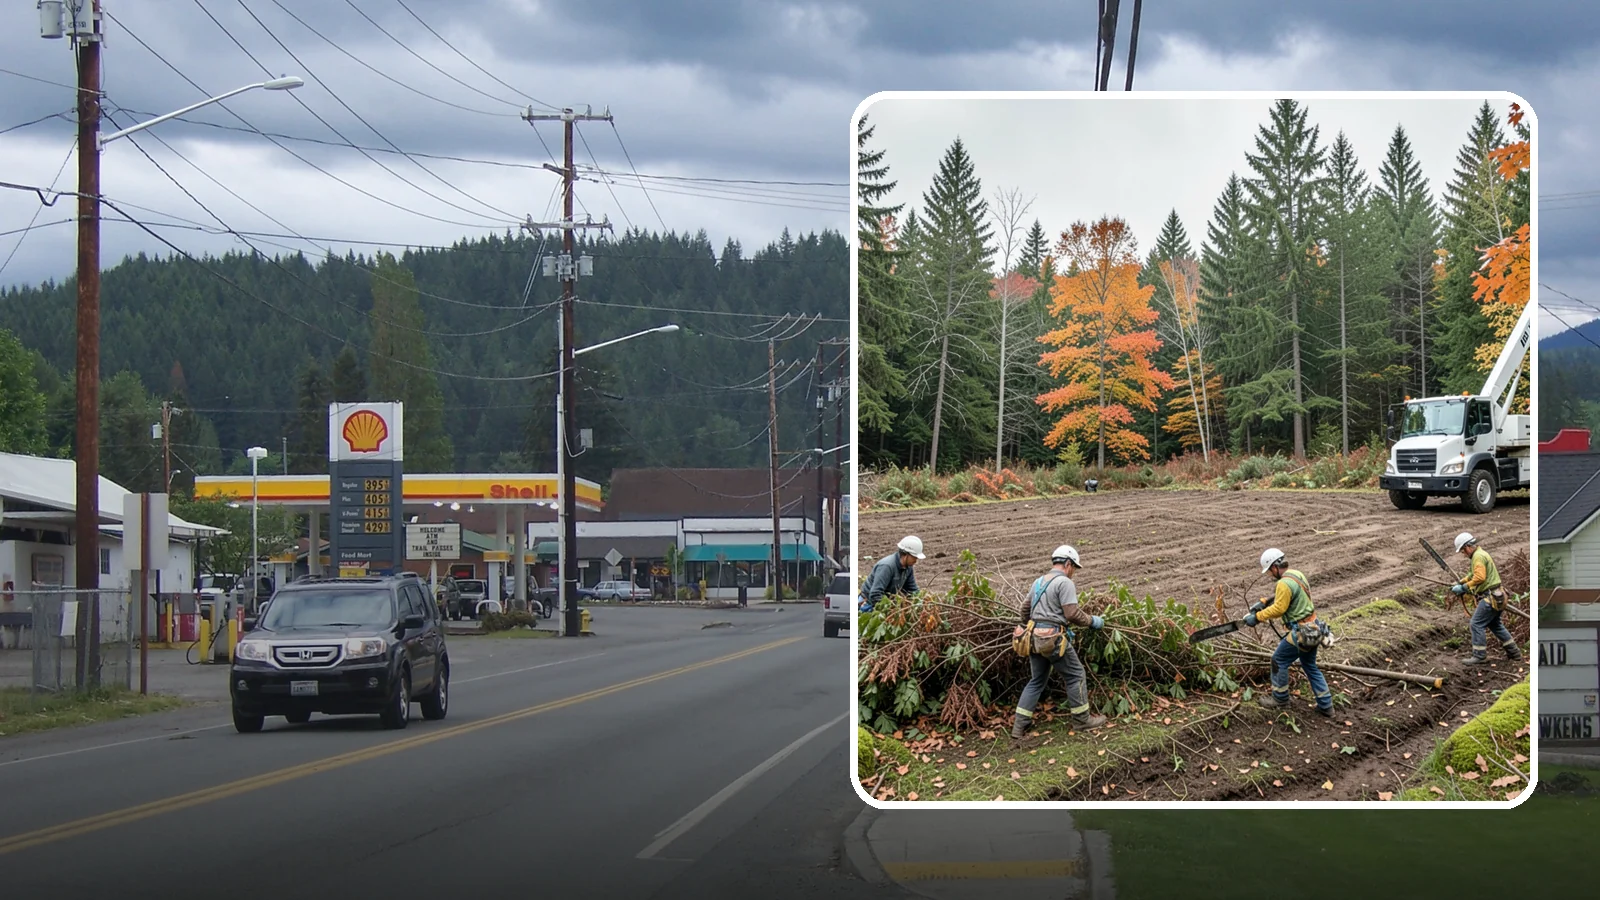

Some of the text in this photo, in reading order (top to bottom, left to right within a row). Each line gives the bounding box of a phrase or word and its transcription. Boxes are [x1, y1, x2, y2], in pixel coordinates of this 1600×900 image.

[365, 480, 383, 490] 395
[490, 484, 547, 499] Shell
[365, 494, 383, 504] 405
[365, 508, 383, 518] 415
[365, 522, 383, 533] 429
